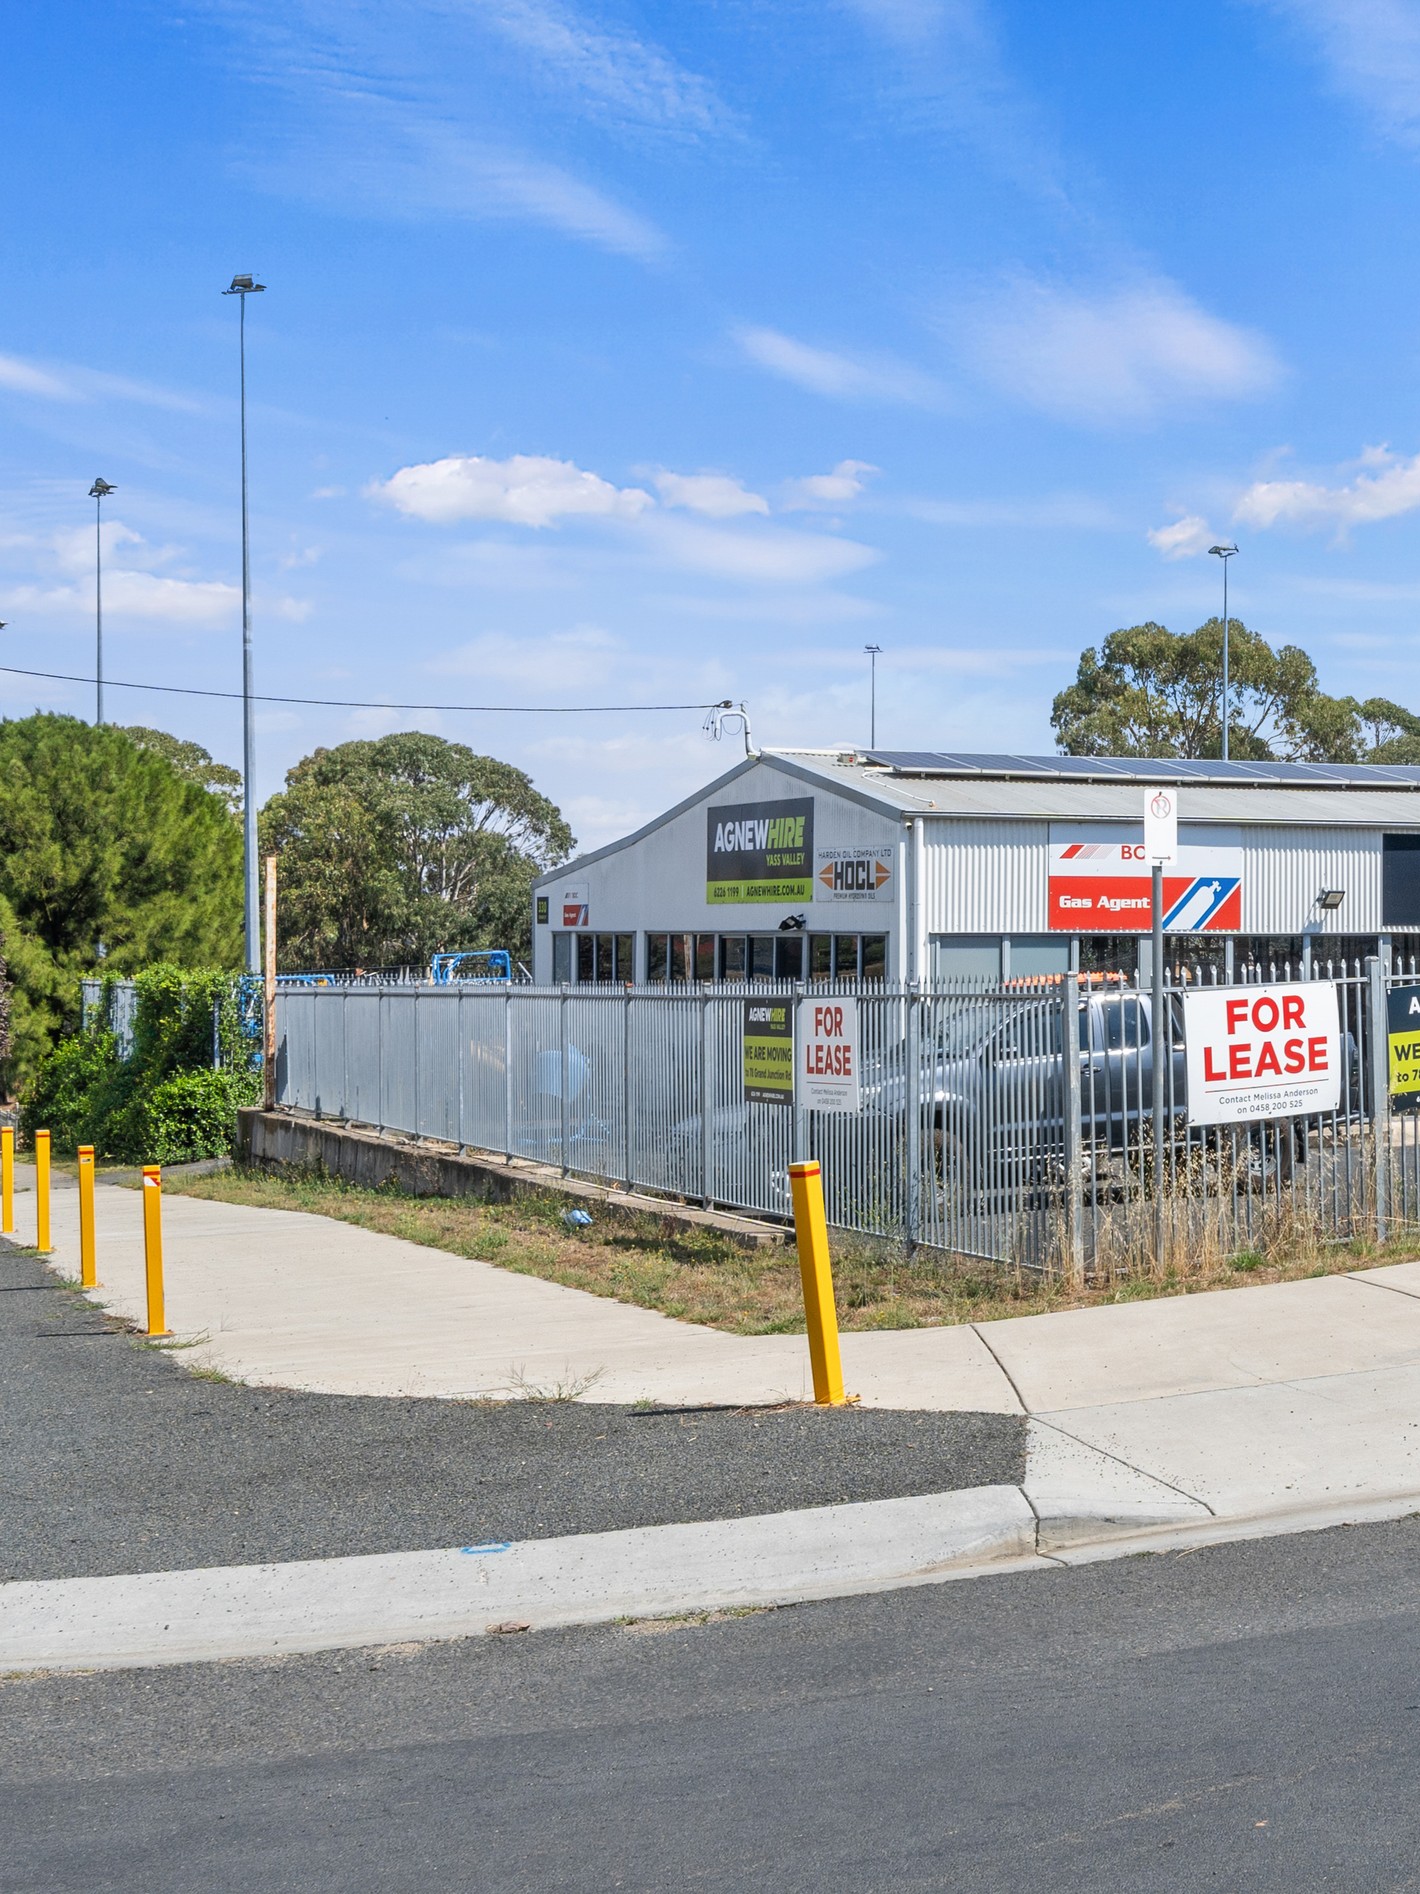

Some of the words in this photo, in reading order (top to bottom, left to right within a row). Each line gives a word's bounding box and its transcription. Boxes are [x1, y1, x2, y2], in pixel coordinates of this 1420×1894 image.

[714, 816, 805, 852] AGNEWHIRE
[766, 853, 781, 866] YASS
[782, 852, 805, 866] VALLEY
[818, 851, 841, 859] HARDEN
[842, 850, 851, 859] OIL
[852, 849, 879, 858] COMPANY
[880, 848, 892, 857] LTD
[834, 860, 875, 890] HOCL
[746, 885, 805, 897] AGNEWHIRE.COM.AU
[1059, 895, 1092, 909] Gas
[1097, 895, 1151, 911] Agent
[749, 1007, 786, 1022] AGNEWHIRE
[814, 1006, 843, 1037] FOR
[1226, 995, 1306, 1035] FOR
[753, 1046, 766, 1061] ARE
[767, 1047, 792, 1062] MOVING
[806, 1045, 851, 1076] LEASE
[1204, 1036, 1328, 1082] LEASE
[1397, 1072, 1409, 1083] to
[1219, 1095, 1251, 1105] Contact
[1253, 1091, 1282, 1101] Melissa
[1284, 1088, 1319, 1098] Anderson
[1250, 1103, 1270, 1113] 0458
[1272, 1102, 1287, 1110] 200
[1289, 1100, 1303, 1108] 525
